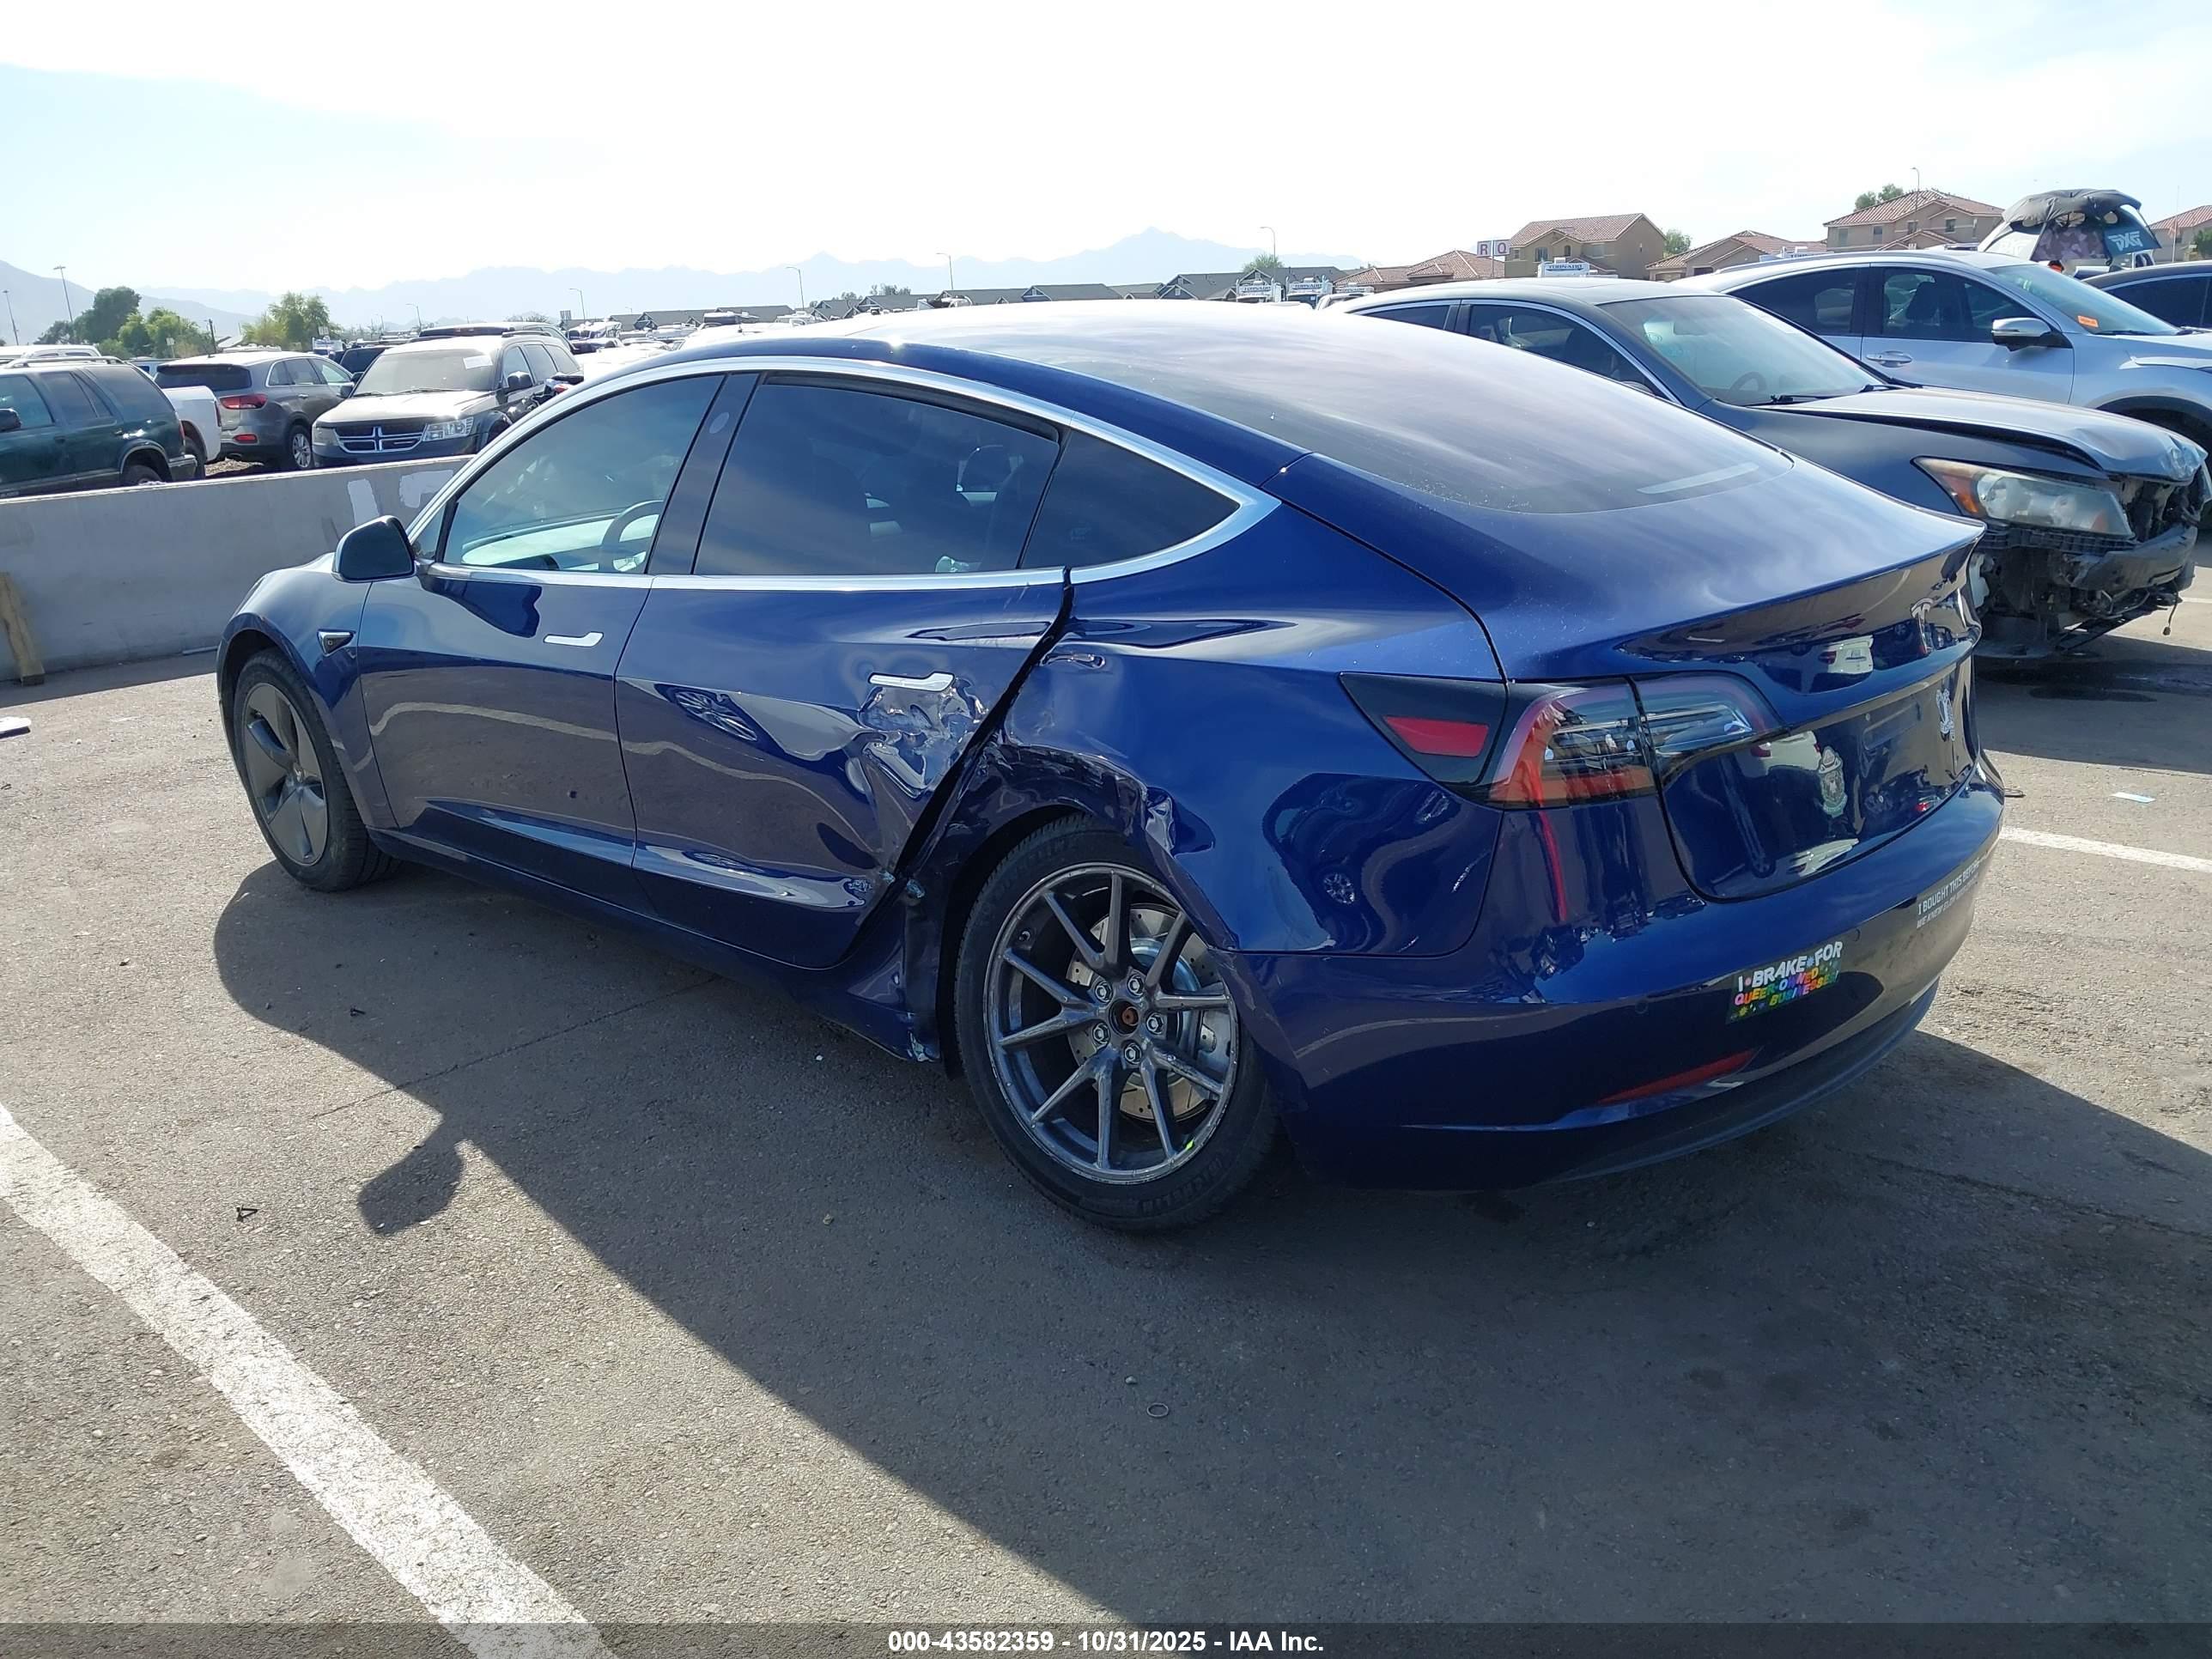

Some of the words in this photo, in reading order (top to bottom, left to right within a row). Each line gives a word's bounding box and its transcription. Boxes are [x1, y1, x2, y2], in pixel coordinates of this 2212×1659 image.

[1480, 243, 1488, 255] R
[1497, 242, 1507, 254] Q
[1917, 902, 1923, 915] I
[1923, 884, 1949, 913] BOUGHT
[1949, 874, 1962, 894] THIS
[1738, 975, 1743, 992] I
[1751, 955, 1808, 988] BRAKE
[1814, 941, 1843, 967] FOR
